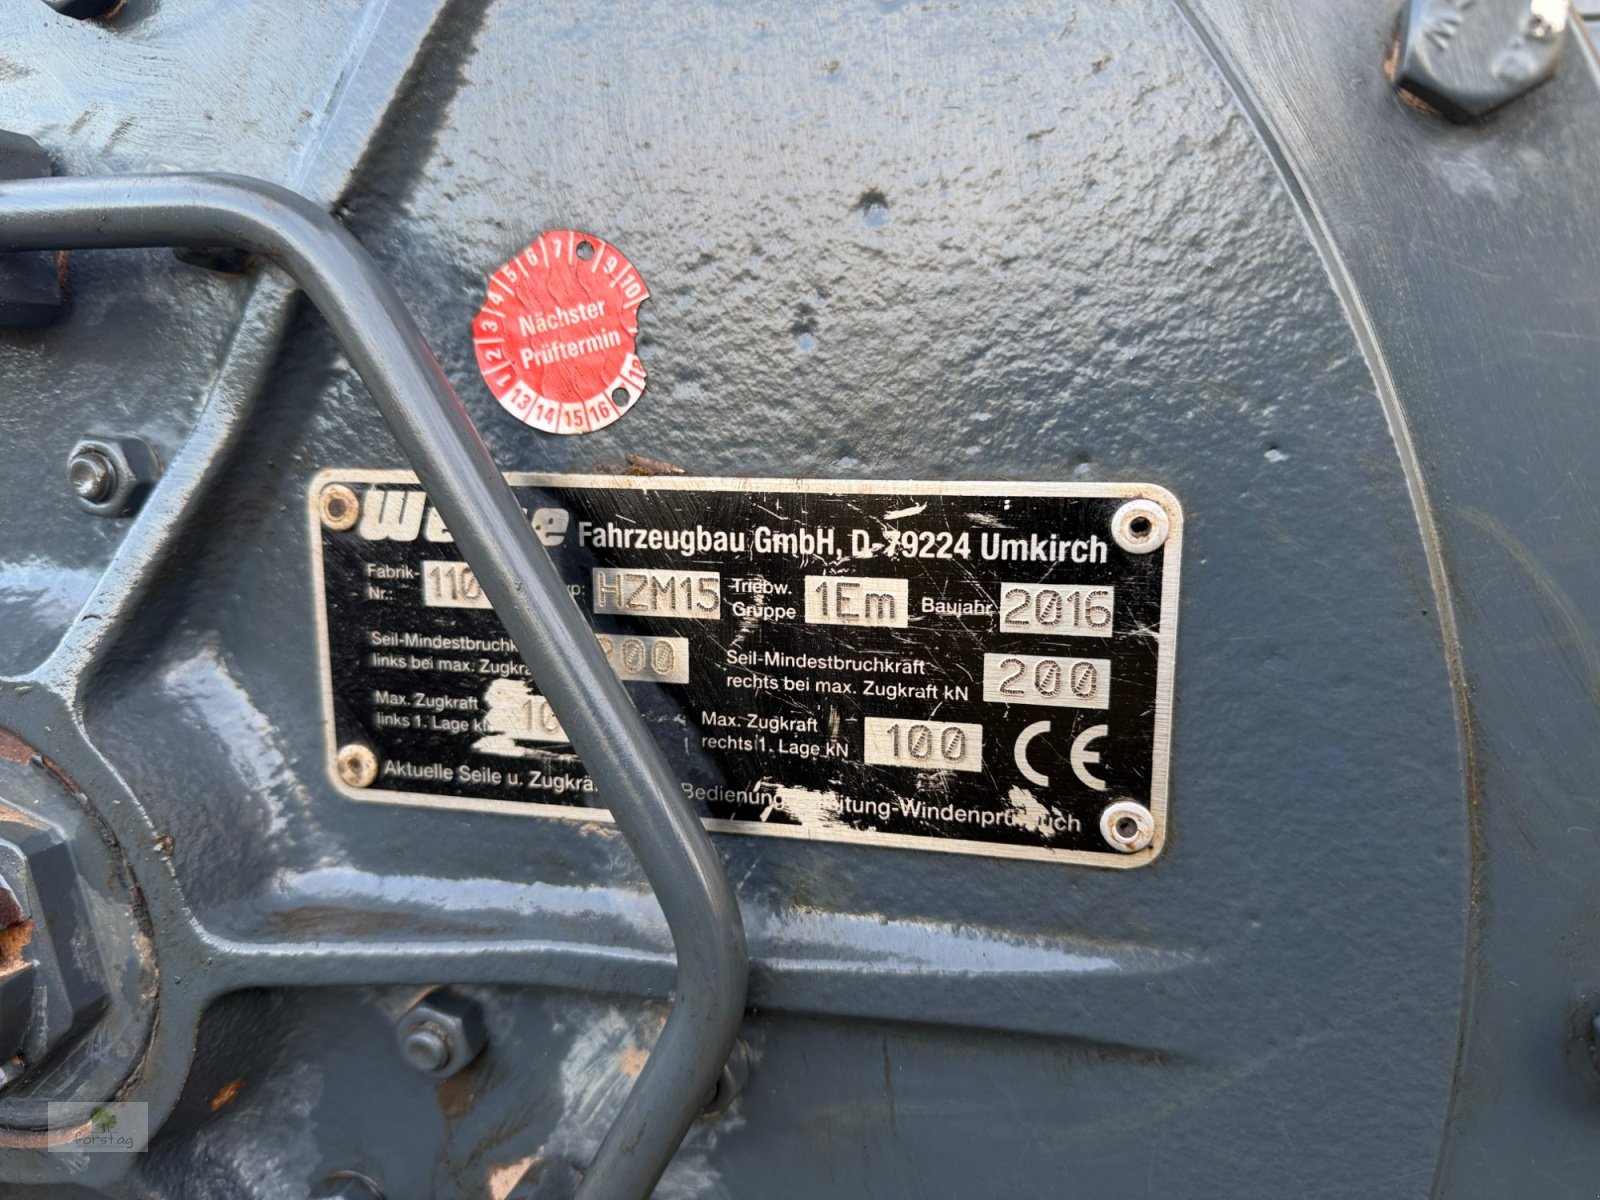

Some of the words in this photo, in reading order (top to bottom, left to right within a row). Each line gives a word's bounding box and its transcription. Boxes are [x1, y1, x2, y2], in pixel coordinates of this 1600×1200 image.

[525, 248, 538, 266] 6
[552, 239, 562, 259] 7
[503, 267, 517, 283] 5
[603, 256, 618, 274] 9
[620, 273, 641, 299] 10
[488, 291, 504, 306] 4
[480, 320, 498, 332] 3
[517, 300, 606, 337] Nächster
[485, 348, 502, 361] 2
[519, 328, 621, 369] Prüftermin
[496, 373, 512, 388] 1
[510, 388, 532, 410] 13
[537, 404, 556, 425] 14
[563, 408, 584, 427] 15
[589, 401, 610, 423] 16
[578, 521, 745, 557] Fahrzeugbau
[754, 526, 843, 560] GmbH,
[851, 530, 971, 561] D-79224
[981, 533, 1108, 564] Umkirch
[367, 563, 420, 580] Fabrik-
[599, 571, 720, 614] HZM15
[731, 577, 792, 595] Triebw.
[732, 601, 797, 621] Gruppe
[814, 580, 898, 622] 1Em
[1004, 587, 1112, 631] 2016
[371, 631, 519, 654] Seil-Mindestbruchk
[373, 654, 407, 669] links
[411, 656, 434, 671] bei
[438, 660, 475, 674] max.
[726, 649, 926, 676] Seil-Mindestbruchkraft
[726, 674, 779, 691] rechts
[785, 676, 810, 692] bei
[815, 679, 857, 695] max.
[863, 680, 939, 701] Zugkraft
[943, 685, 969, 701] kN
[999, 658, 1099, 700] 200
[375, 690, 411, 706] Max.
[414, 692, 478, 711] Zugkraft
[376, 711, 410, 727] links
[413, 714, 426, 729] 1.
[432, 717, 469, 734] Lage
[522, 699, 561, 732] 10
[702, 711, 742, 729] Max.
[747, 713, 819, 734] Zugkraft
[702, 734, 755, 752] rechts
[779, 740, 822, 761] Lage
[826, 742, 850, 759] kN
[887, 722, 967, 762] 100
[1014, 719, 1109, 792] CE
[384, 758, 454, 783] Aktuelle
[458, 763, 502, 786] Seile
[508, 772, 524, 786] u.
